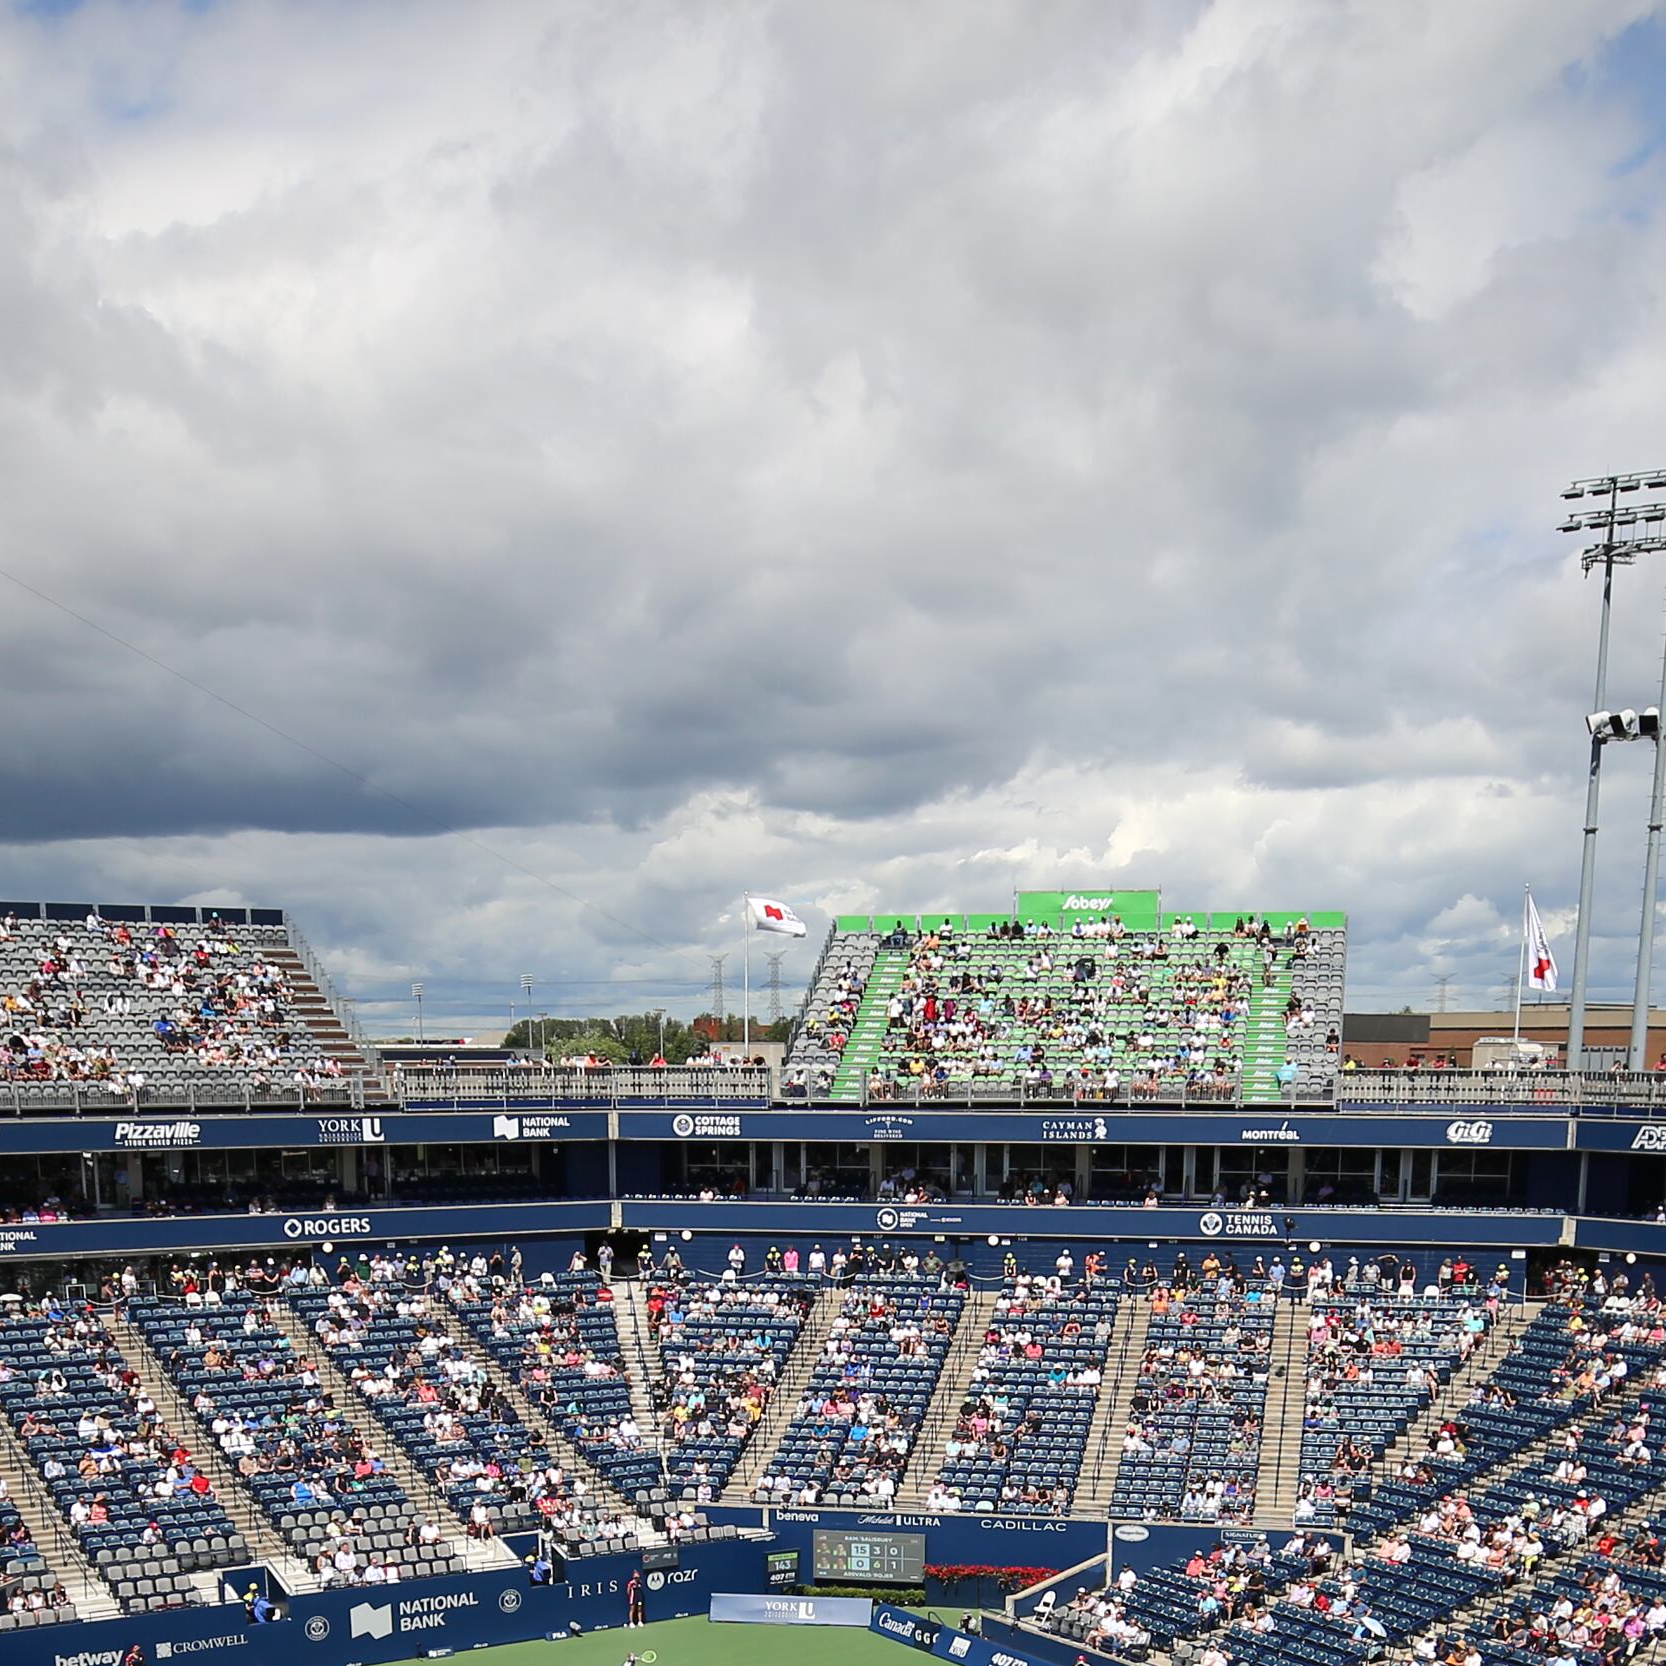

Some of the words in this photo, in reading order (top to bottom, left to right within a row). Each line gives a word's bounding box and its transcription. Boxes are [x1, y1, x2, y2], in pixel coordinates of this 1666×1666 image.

[1062, 894, 1113, 912] Sobeys
[318, 1119, 361, 1133] YORK
[522, 1116, 570, 1128] NATIONAL
[695, 1116, 741, 1126] COTTAGE
[1043, 1121, 1092, 1130] CAYMAN
[115, 1122, 201, 1140] Pizzaville
[522, 1127, 550, 1138] BANK
[695, 1126, 741, 1136] SPRINGS
[1043, 1131, 1092, 1139] ISLANDS
[304, 1217, 370, 1236] ROGERS
[1226, 1215, 1272, 1226] TENNIS
[1226, 1225, 1277, 1236] CANADA
[776, 1510, 819, 1522] beneva
[903, 1515, 941, 1527] ULTRA
[981, 1519, 1067, 1532] CADILLAC
[854, 1546, 866, 1555] 15
[873, 1546, 881, 1555] 3
[889, 1547, 898, 1556] 0
[775, 1560, 791, 1570] 143
[856, 1560, 864, 1569] 0
[873, 1560, 881, 1569] 6
[891, 1561, 897, 1570] 1
[667, 1568, 699, 1584] razr
[399, 1592, 478, 1616] NATIONAL
[765, 1601, 797, 1611] YORK
[399, 1613, 446, 1633] BANK
[879, 1611, 913, 1637] Canada
[915, 1629, 922, 1641] G
[923, 1632, 930, 1644] G
[173, 1633, 248, 1654] CROMWELL
